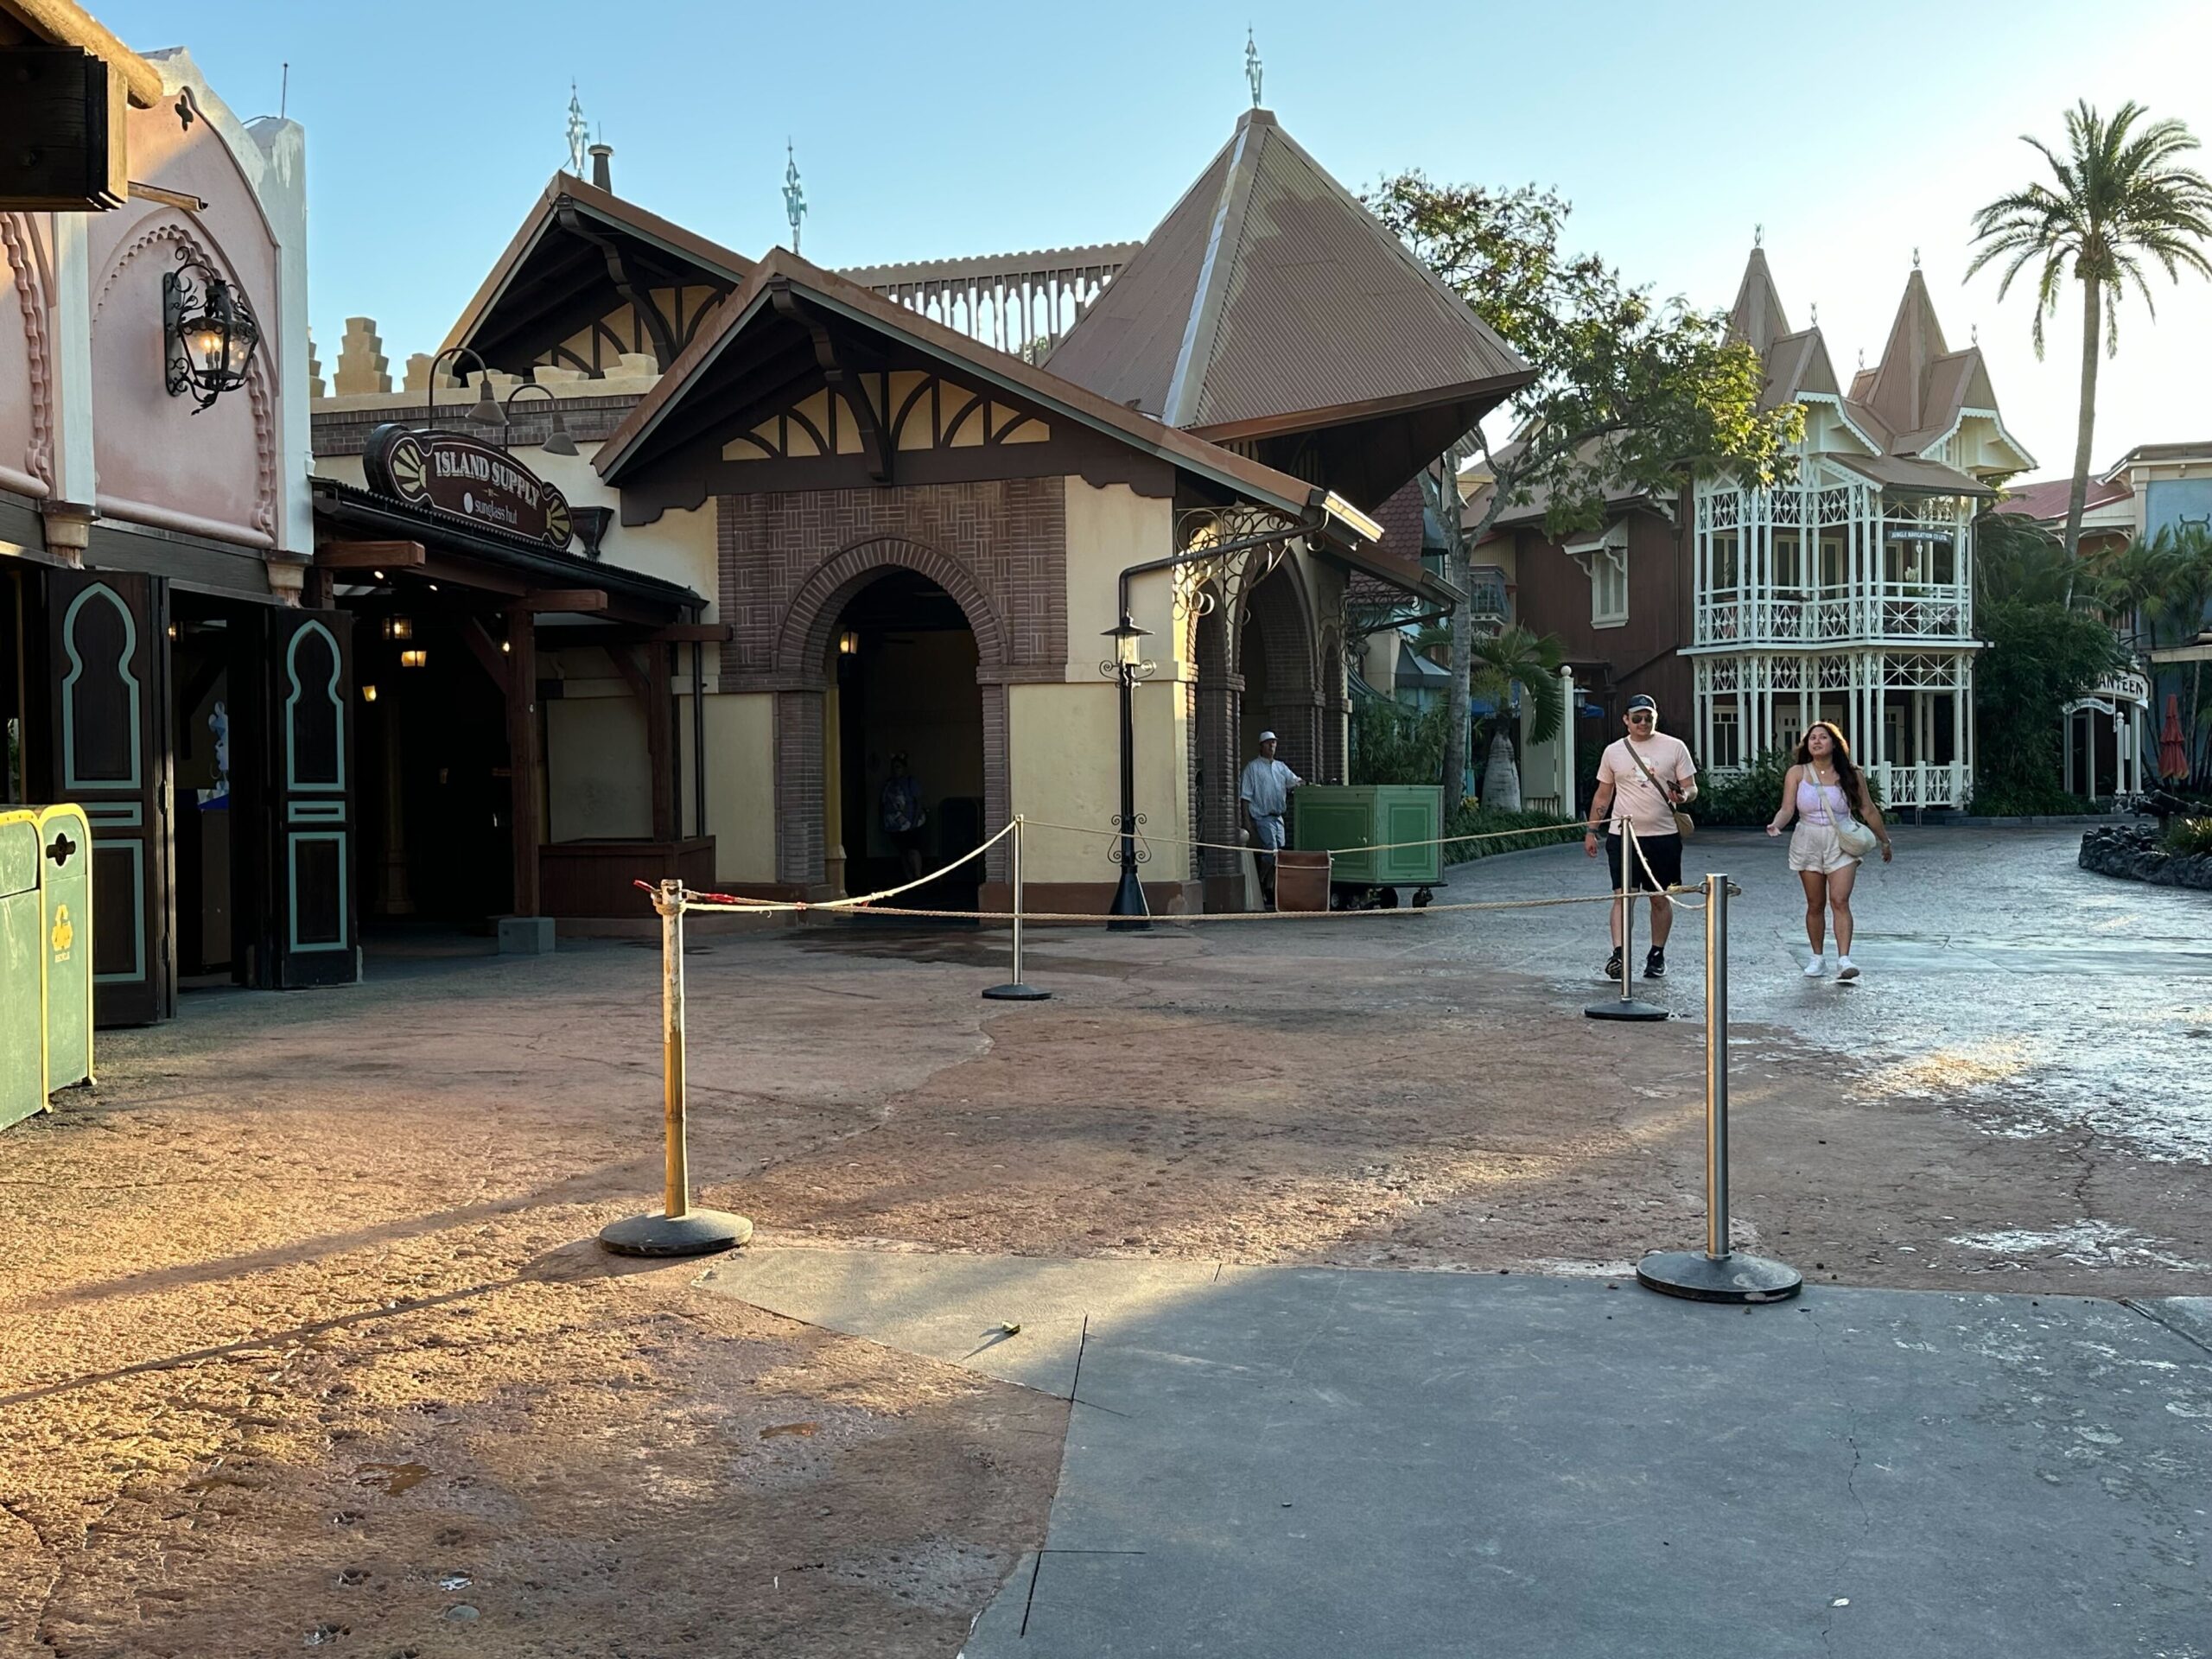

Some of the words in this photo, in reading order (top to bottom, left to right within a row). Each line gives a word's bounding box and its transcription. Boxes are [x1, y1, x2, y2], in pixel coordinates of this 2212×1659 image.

[434, 451, 490, 481] ISLAND
[492, 461, 540, 510] SUPPLY
[474, 499, 505, 521] sunglass
[505, 505, 518, 524] hut
[2097, 673, 2144, 695] ANTEEN
